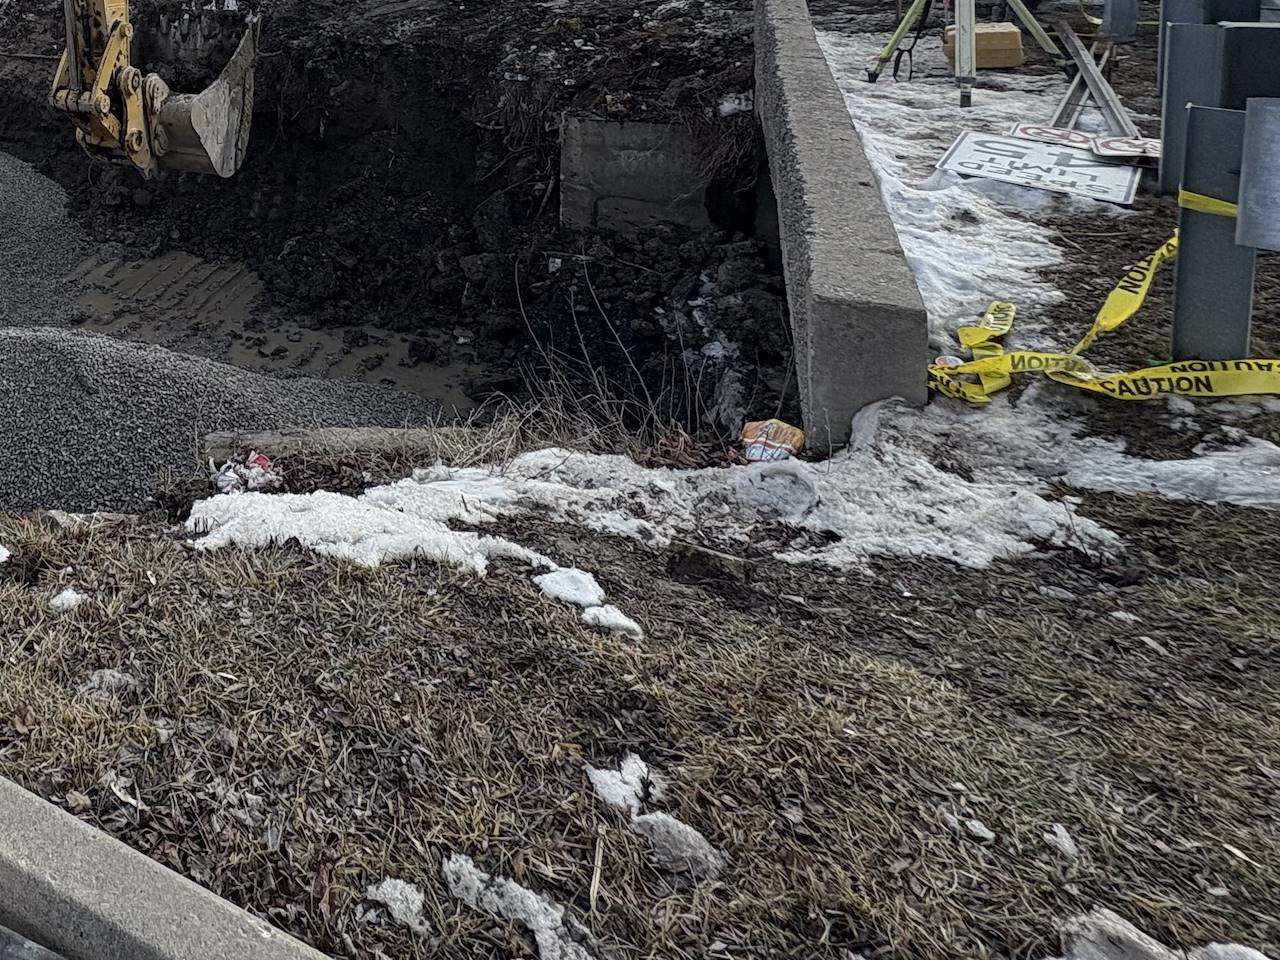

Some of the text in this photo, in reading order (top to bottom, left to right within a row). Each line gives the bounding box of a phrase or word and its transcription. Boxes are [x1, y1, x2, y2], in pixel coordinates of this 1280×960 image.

[972, 139, 1123, 168] 45
[958, 161, 1111, 194] SPEED
[980, 157, 1097, 182] LIMIT
[1169, 361, 1280, 373] AUTION
[1099, 376, 1213, 397] CAUTION
